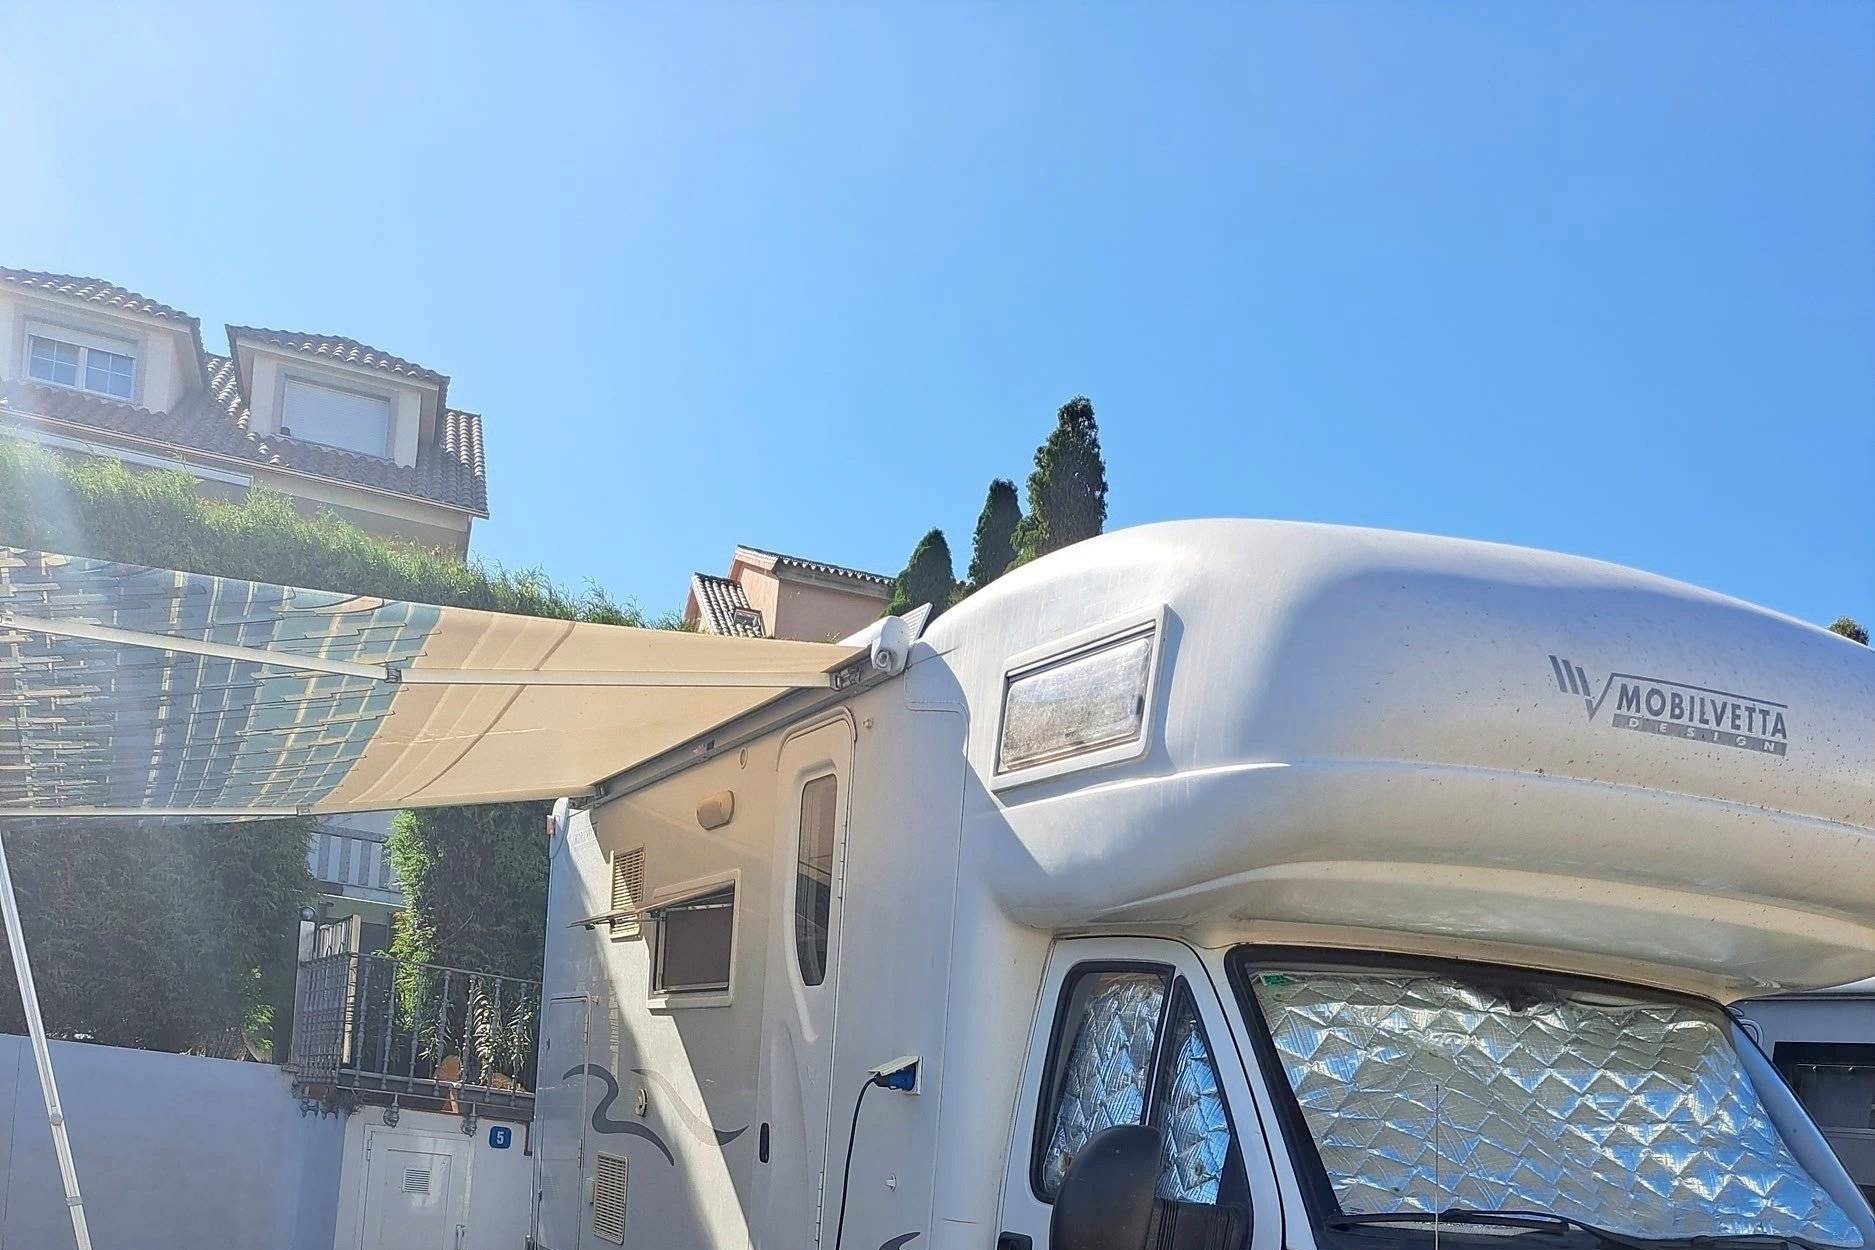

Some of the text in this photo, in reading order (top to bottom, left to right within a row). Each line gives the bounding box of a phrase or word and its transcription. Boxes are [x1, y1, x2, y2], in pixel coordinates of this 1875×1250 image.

[1617, 683, 1788, 740] MOBILVETTA
[1629, 718, 1776, 752] DESIGN
[496, 1130, 505, 1145] 5
